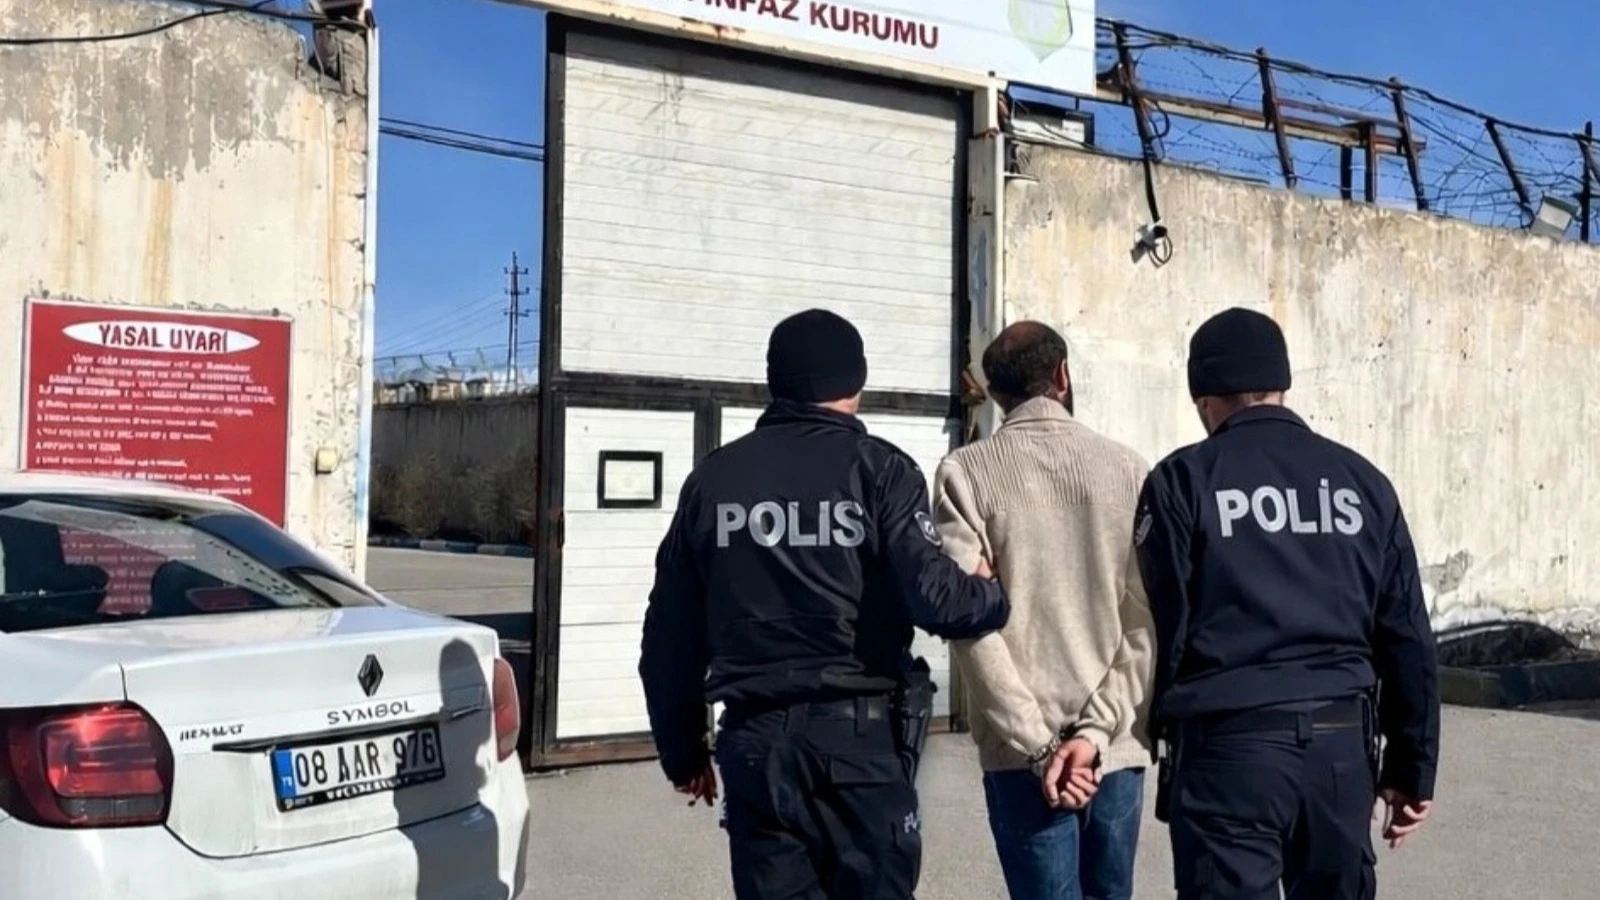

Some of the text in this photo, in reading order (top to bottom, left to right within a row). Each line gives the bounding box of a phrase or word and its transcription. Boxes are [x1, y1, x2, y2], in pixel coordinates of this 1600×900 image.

[705, 0, 939, 49] FAZ KURUMU
[98, 324, 228, 352] YASAL UYARI
[1215, 478, 1363, 537] POLİS
[327, 700, 415, 725] SYMBOL
[295, 750, 328, 787] 08
[337, 741, 382, 783] AAR
[392, 731, 436, 777] 976
